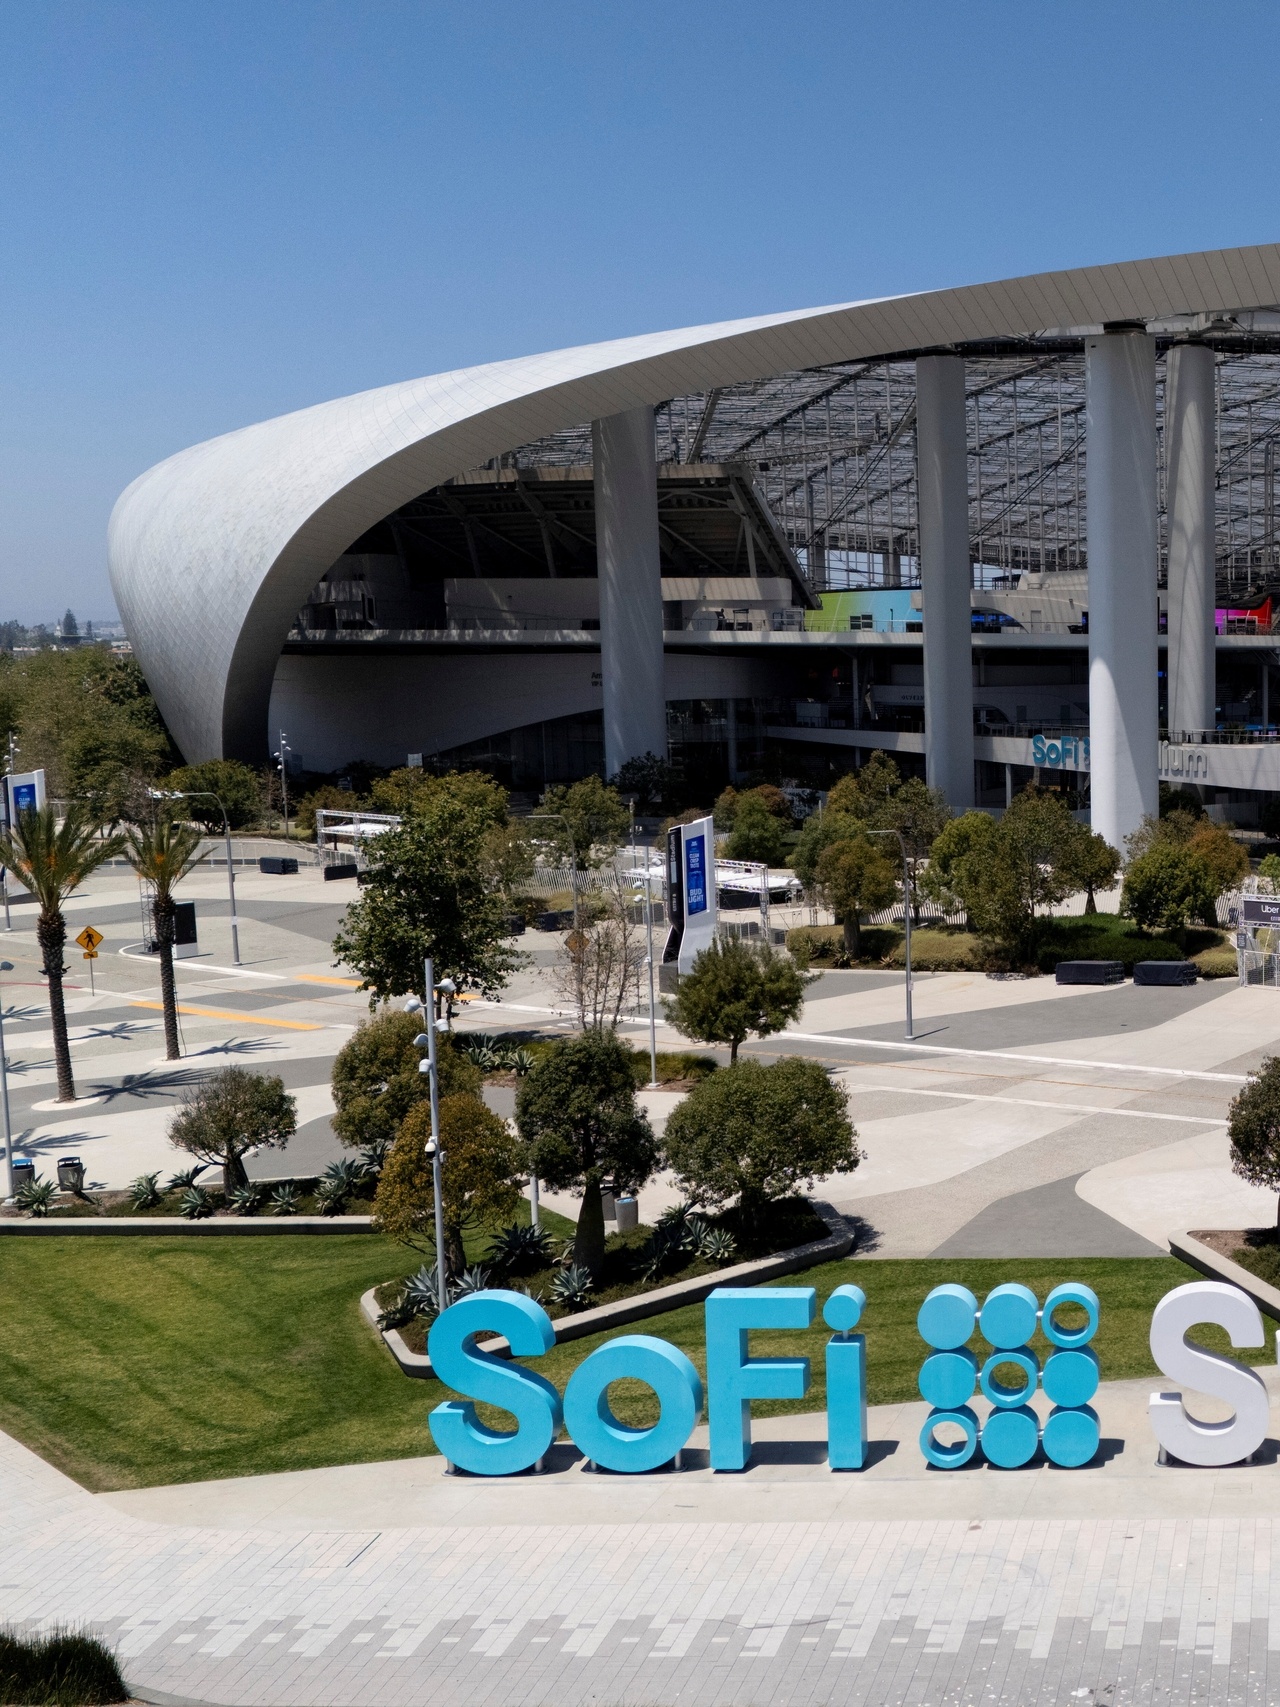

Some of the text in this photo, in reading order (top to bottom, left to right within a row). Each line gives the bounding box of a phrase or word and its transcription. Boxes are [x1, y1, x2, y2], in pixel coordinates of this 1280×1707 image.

[1032, 734, 1080, 765] SoFi
[688, 894, 704, 903] LIGHT
[1261, 904, 1280, 914] Uber
[428, 1283, 868, 1475] SoFi
